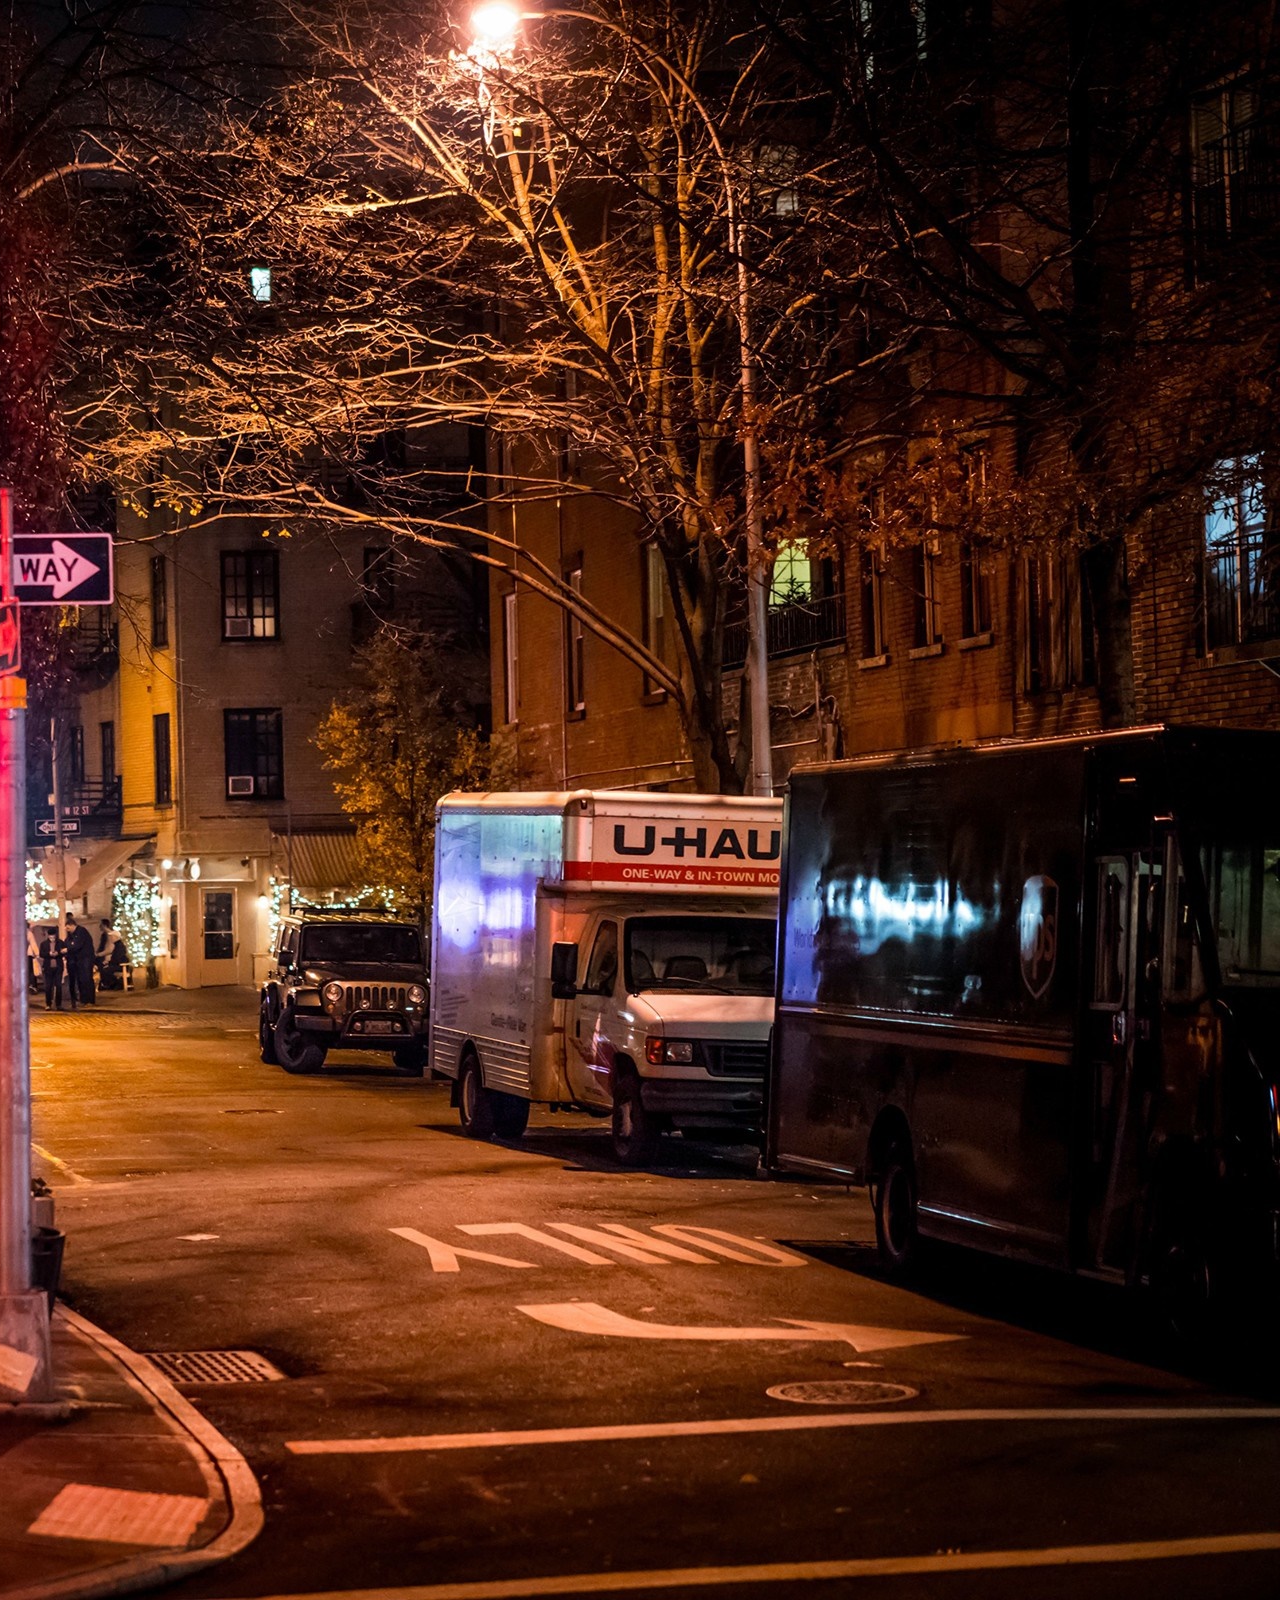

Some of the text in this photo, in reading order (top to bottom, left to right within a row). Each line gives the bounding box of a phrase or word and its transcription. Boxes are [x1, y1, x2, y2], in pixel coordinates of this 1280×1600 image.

[19, 558, 79, 582] WAY
[82, 806, 89, 815] ST
[614, 824, 781, 860] U-HAU
[622, 867, 682, 880] ONE-WAY
[684, 870, 695, 881] &
[698, 871, 755, 883] IN-TOWN
[386, 1221, 809, 1272] ONLY
